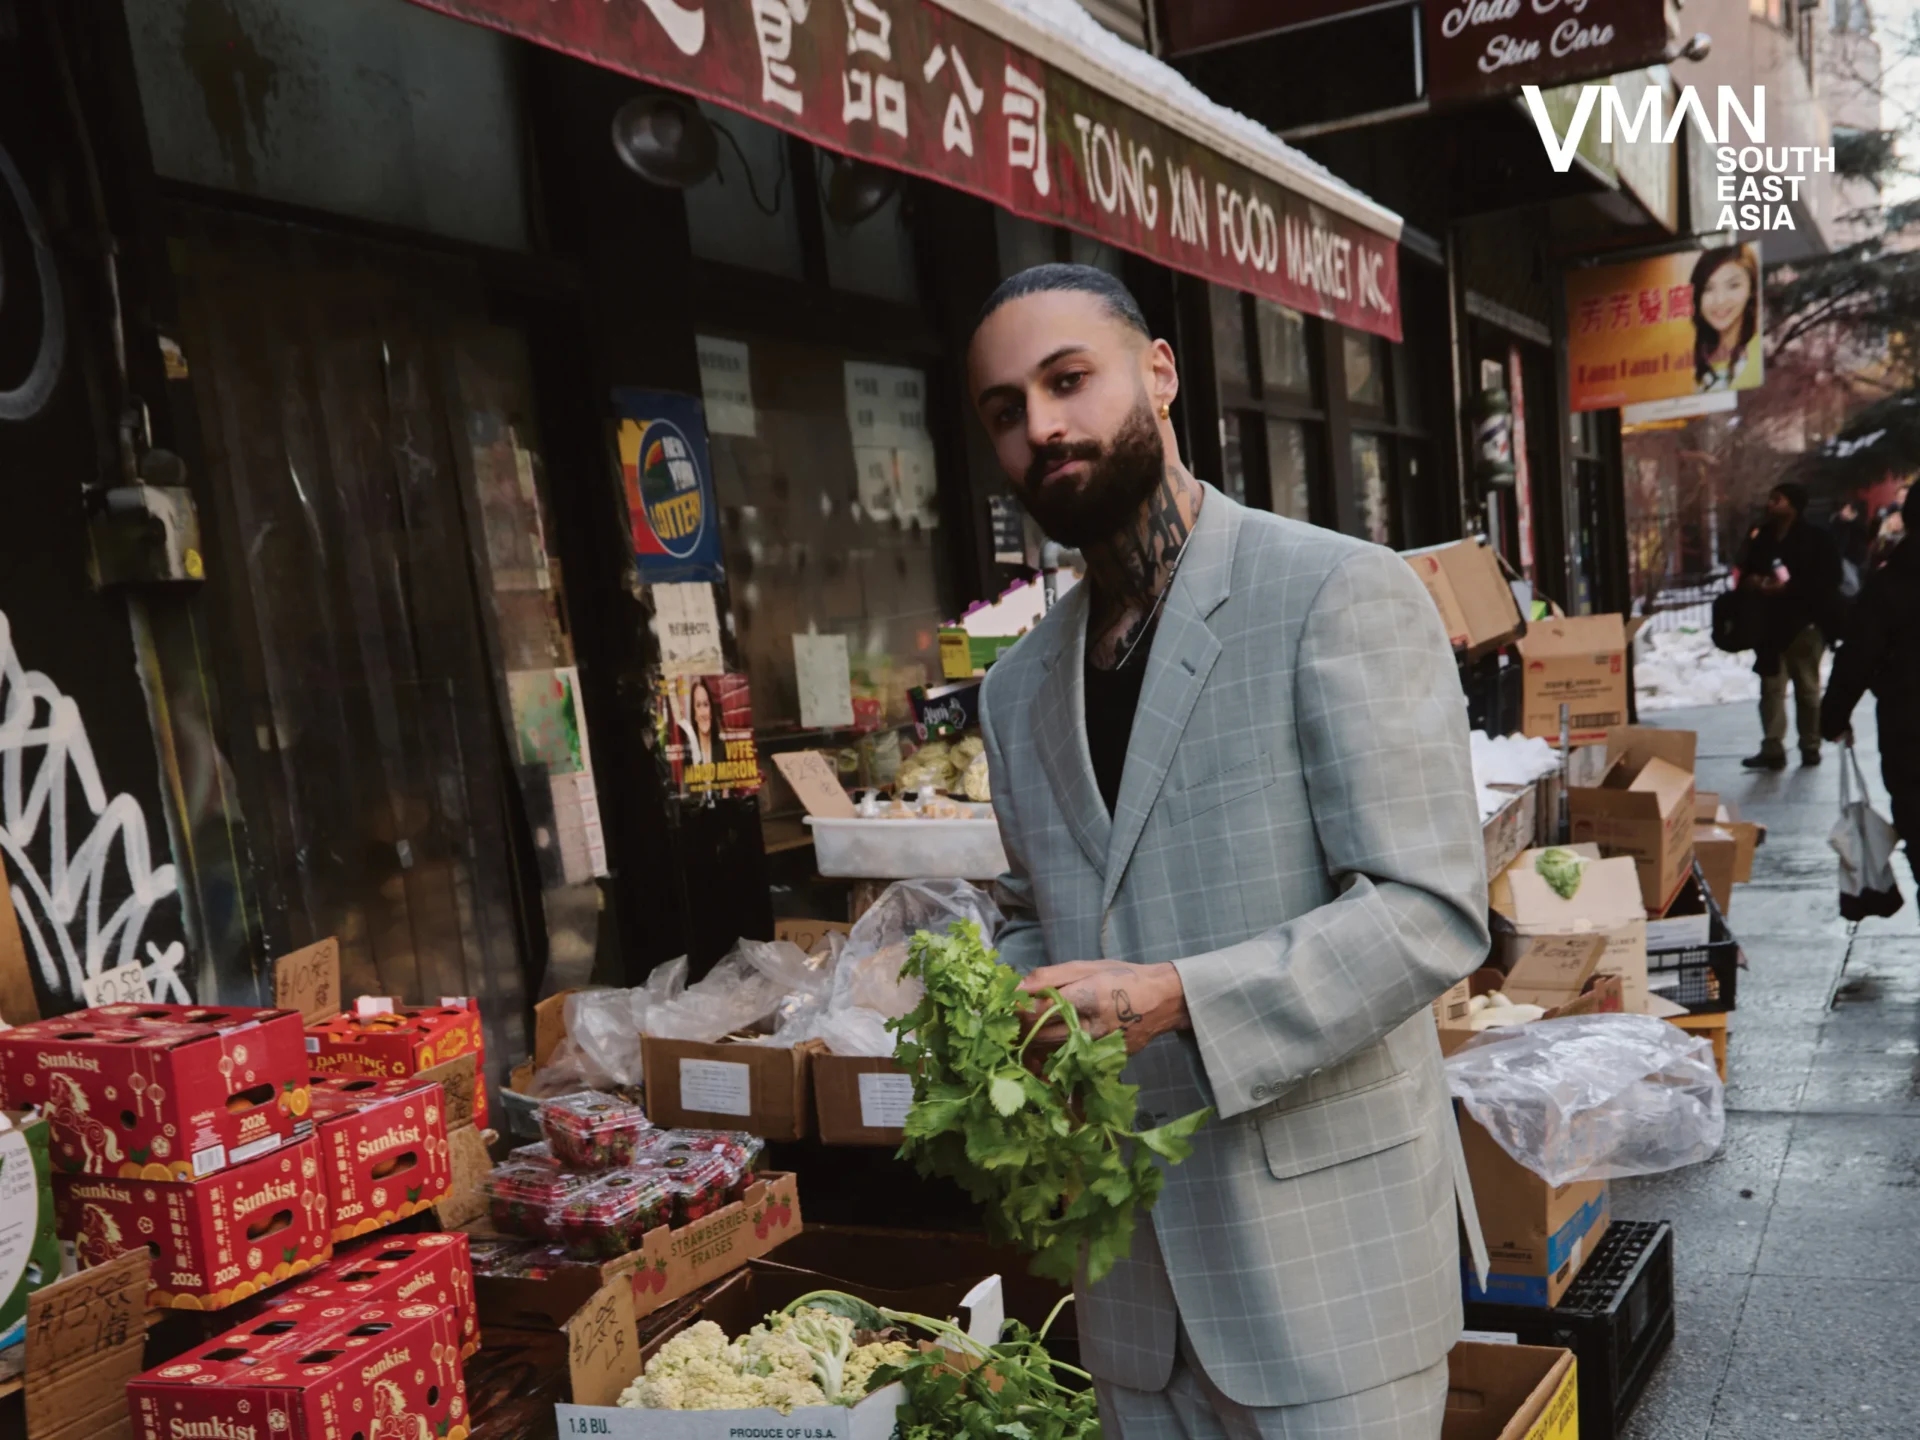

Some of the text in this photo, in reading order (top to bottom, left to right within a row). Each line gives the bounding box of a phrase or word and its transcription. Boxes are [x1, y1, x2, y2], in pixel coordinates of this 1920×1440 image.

[1477, 18, 1616, 74] Skin Care
[1073, 113, 1158, 231] TONG
[1166, 156, 1209, 251] XIN
[1216, 182, 1279, 274] FOOD
[1284, 214, 1353, 303] MARKET
[725, 740, 755, 760] VOTE
[37, 1051, 101, 1073] Sunkist
[240, 1112, 266, 1133] 2026
[357, 1124, 421, 1163] Sunkist
[70, 1183, 133, 1204] Sunkist
[232, 1179, 298, 1221] Sunkist
[336, 1201, 364, 1221] 2026
[670, 1207, 749, 1258] STRAWBERRIES
[691, 1237, 733, 1269] FRAISES
[170, 1272, 203, 1287] 2026
[213, 1263, 241, 1286] 2026
[397, 1267, 436, 1302] Sunkist
[361, 1347, 412, 1386] Sunkist
[169, 1416, 257, 1440] Sunkist
[568, 1417, 612, 1435] 1.8 BU.
[730, 1427, 837, 1439] PRODUCE OF U.S.A.
